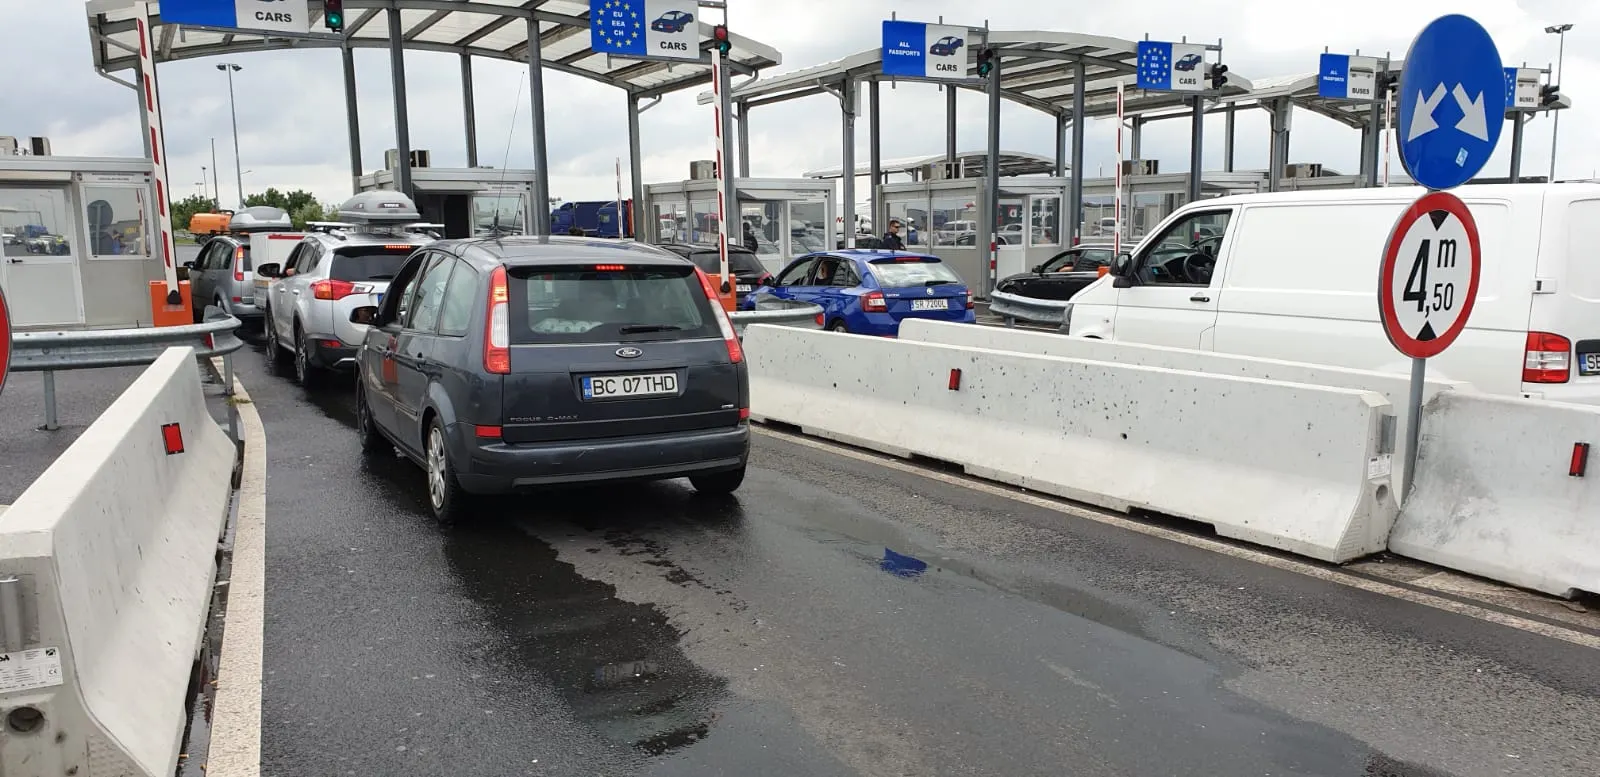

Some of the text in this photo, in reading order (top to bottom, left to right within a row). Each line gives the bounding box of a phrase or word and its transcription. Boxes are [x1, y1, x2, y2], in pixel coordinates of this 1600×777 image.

[255, 11, 292, 23] CARS
[660, 41, 687, 51] CARS
[888, 49, 920, 57] PASSPORTS
[936, 63, 958, 72] CARS
[1179, 77, 1197, 85] CARS
[1351, 87, 1370, 95] BUSES
[592, 379, 616, 395] BC
